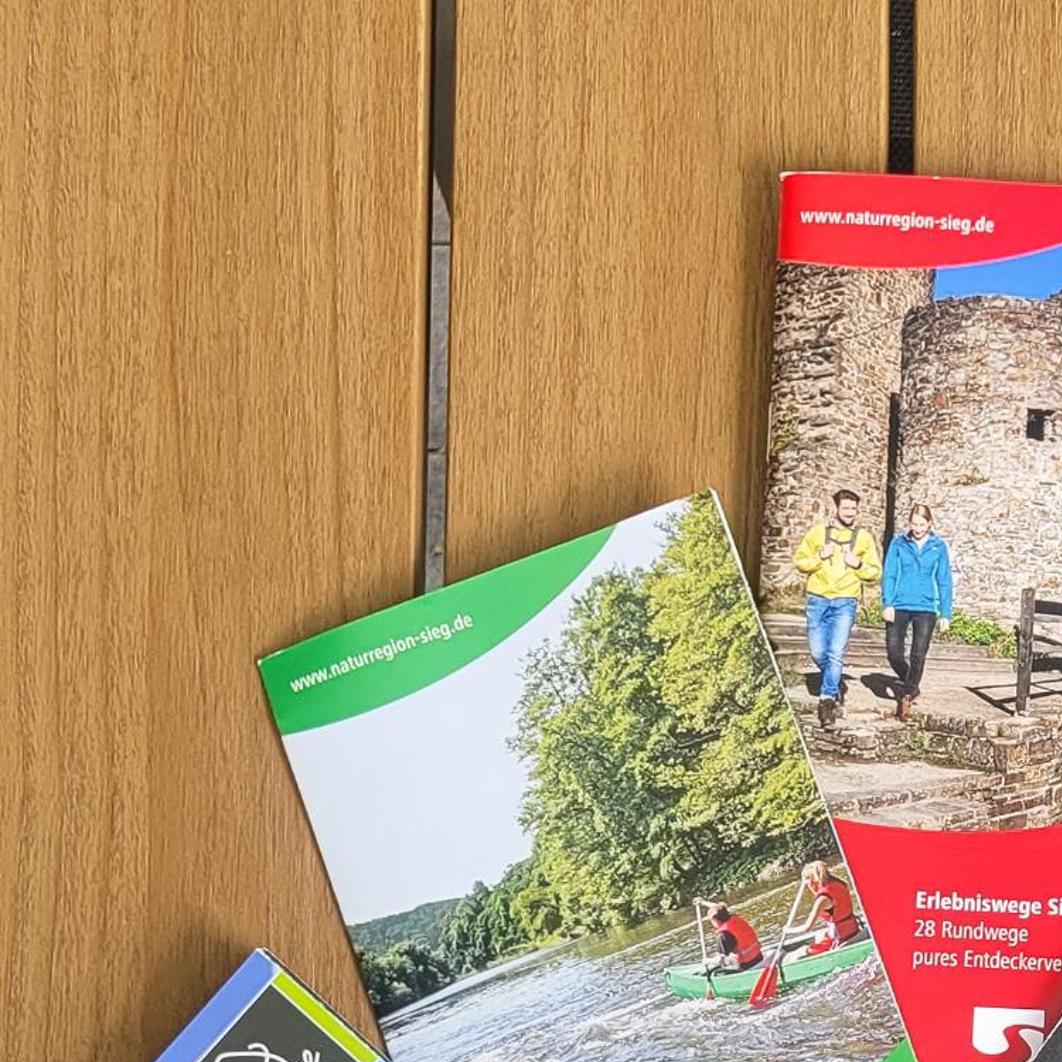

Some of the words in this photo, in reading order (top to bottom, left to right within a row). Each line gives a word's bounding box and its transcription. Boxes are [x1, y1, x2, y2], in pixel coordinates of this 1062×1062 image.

[800, 210, 994, 235] www.naturregion-sieg.de
[290, 612, 473, 694] www.naturregion-sieg.de
[915, 890, 1042, 919] Erlebniswege
[914, 919, 936, 938] 28
[942, 922, 1029, 946] Rundwege
[912, 950, 958, 970] pures
